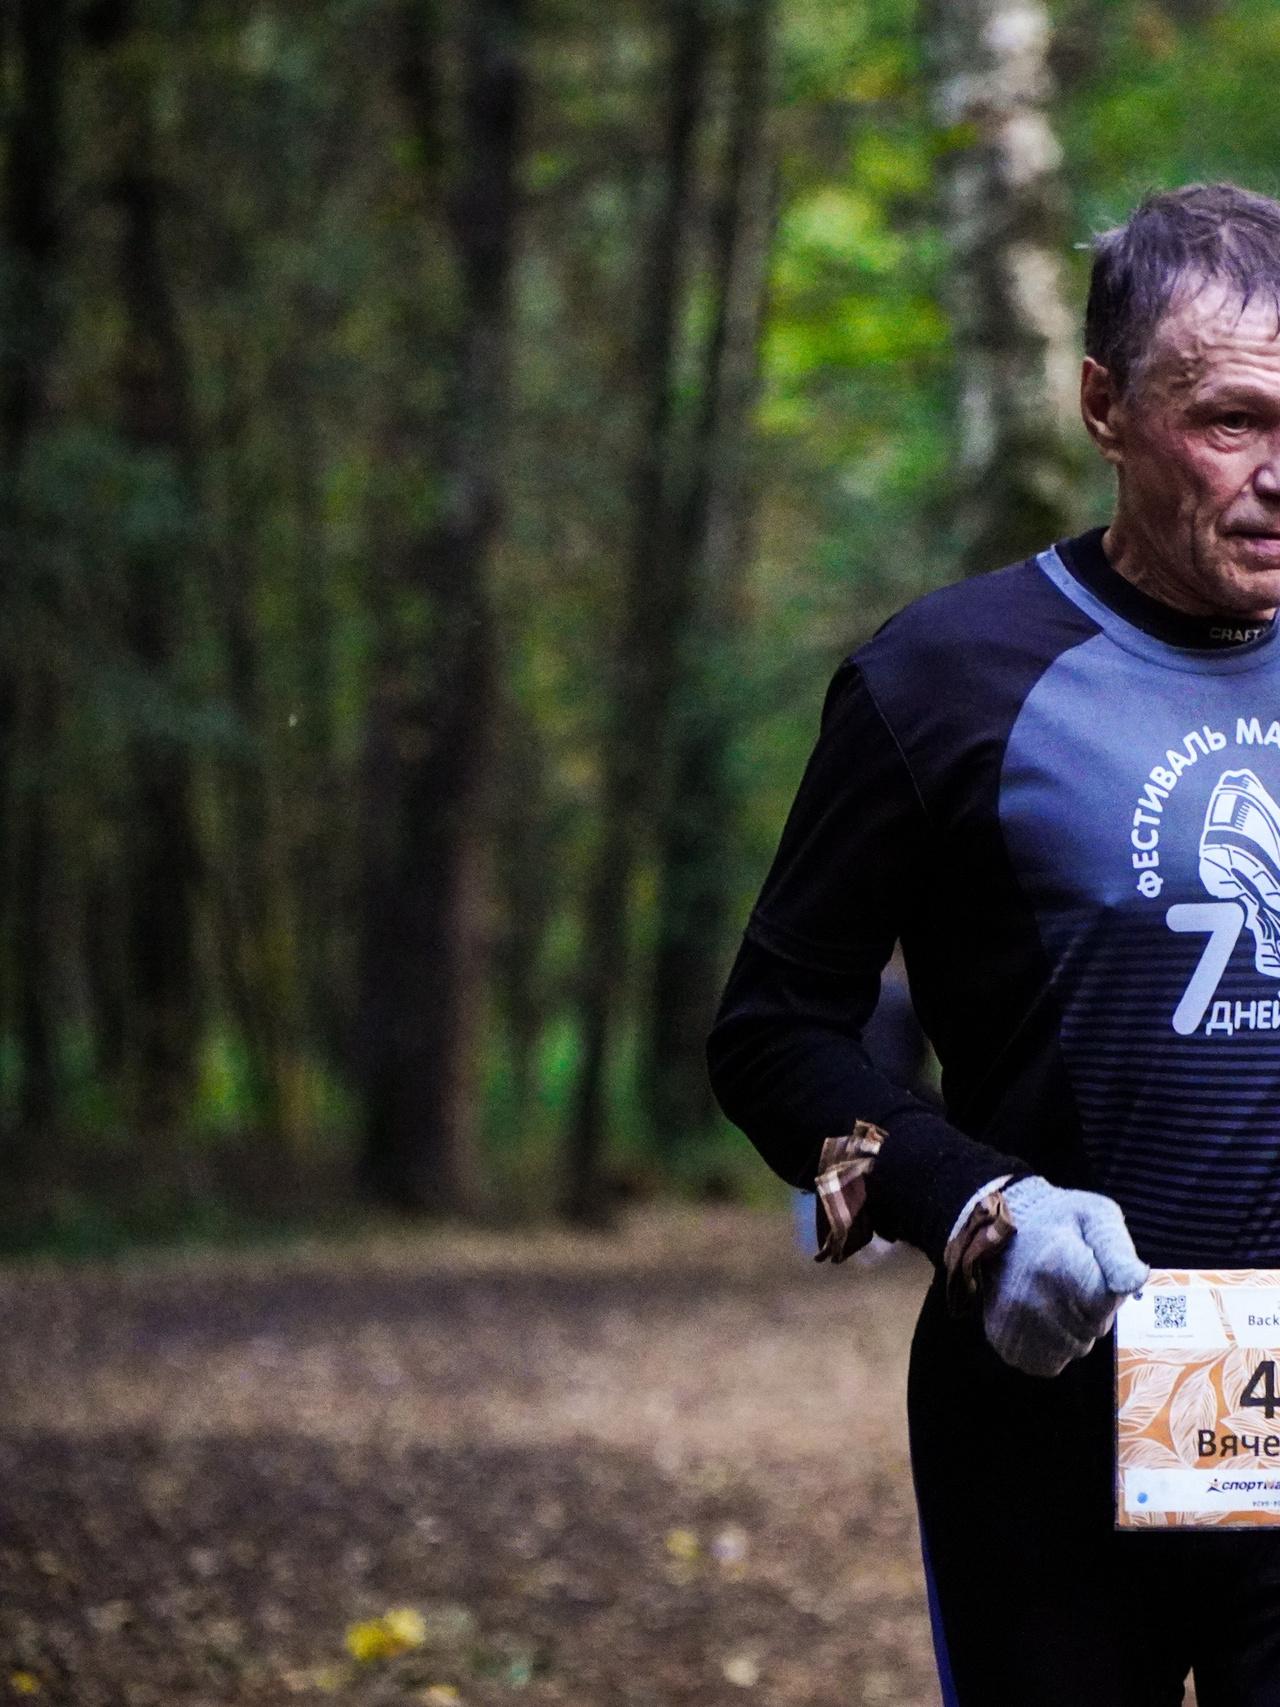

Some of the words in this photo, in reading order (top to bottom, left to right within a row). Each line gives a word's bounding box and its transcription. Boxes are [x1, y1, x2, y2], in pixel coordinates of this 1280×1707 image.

[1210, 627, 1262, 642] CRAFT
[1131, 725, 1227, 898] ФЕСТИВАЛЬ
[1165, 901, 1245, 1035] 7
